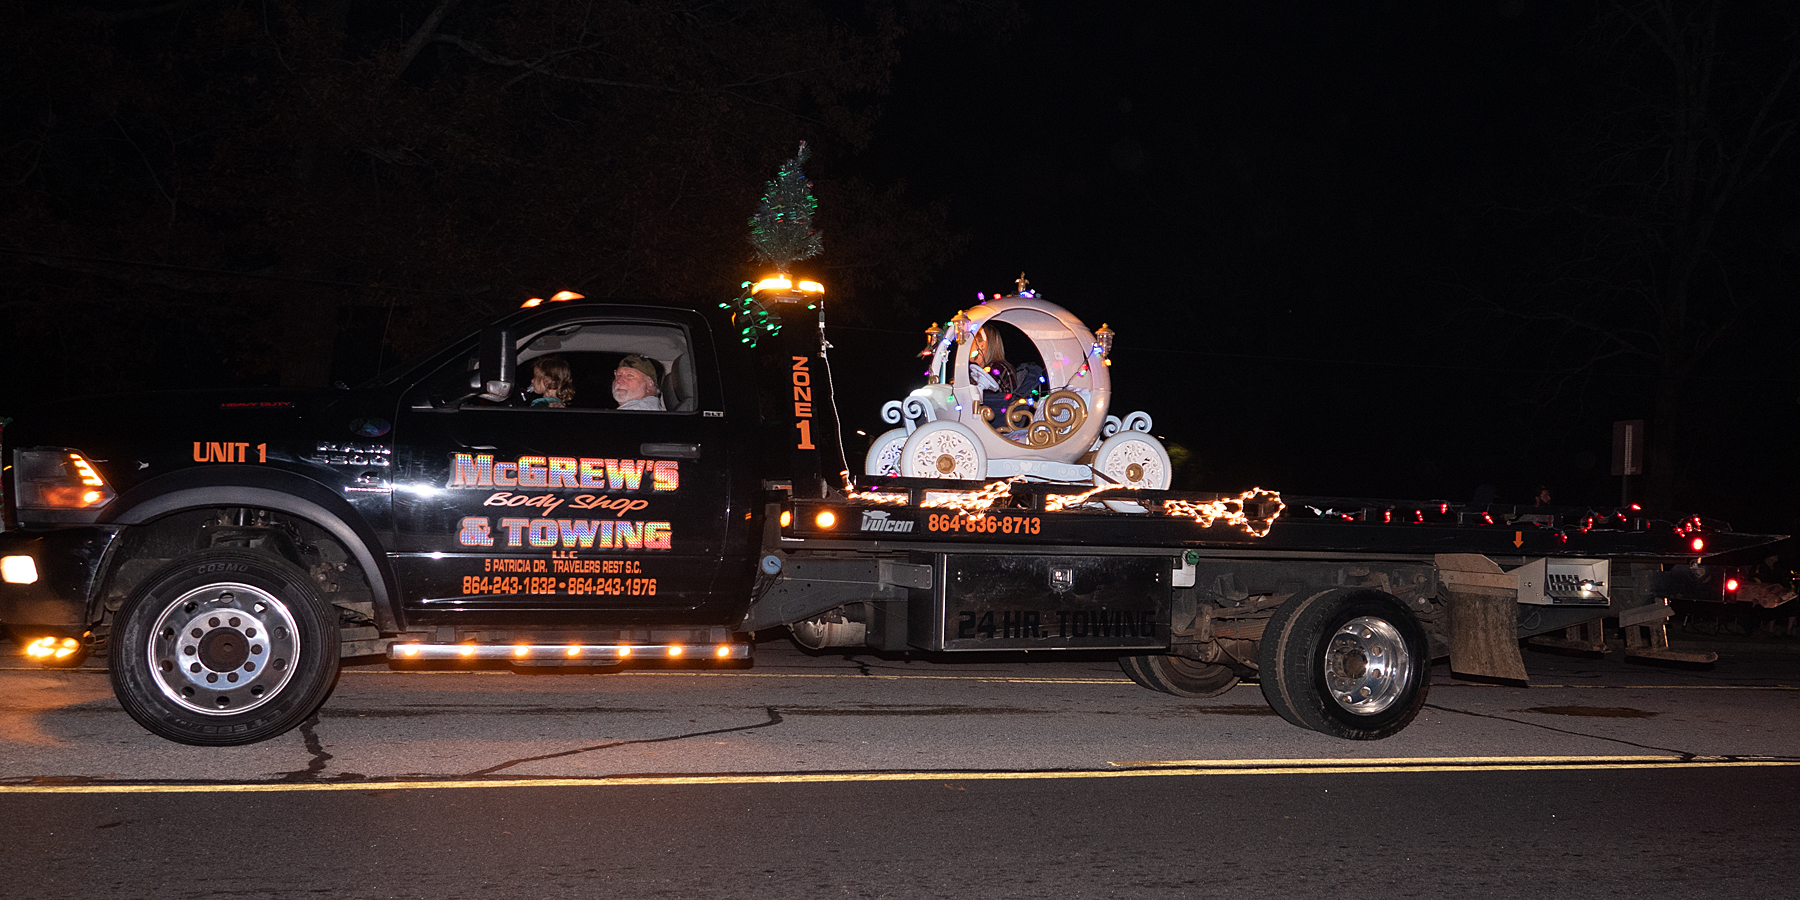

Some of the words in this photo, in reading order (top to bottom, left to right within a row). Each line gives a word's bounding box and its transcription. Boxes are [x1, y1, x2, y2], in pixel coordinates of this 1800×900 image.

[792, 355, 813, 418] ZONE
[796, 419, 816, 450] 1
[193, 441, 250, 463] UNIT
[256, 442, 267, 463] 1
[483, 492, 565, 517] Body
[568, 493, 649, 517] Shop
[459, 516, 495, 547] &
[502, 518, 672, 549] TOWING
[861, 512, 915, 532] Vulcan
[928, 513, 1041, 535] 864-836-8713
[552, 551, 578, 559] LLC
[485, 560, 491, 572] 5
[493, 559, 531, 573] PATRICIA
[533, 560, 548, 573] DR.
[553, 560, 600, 574] TRAVELERS
[602, 561, 624, 574] REST
[625, 561, 642, 574] S.C.
[463, 576, 556, 595] 864-243-1832
[567, 577, 657, 596] 864-243-1976
[958, 610, 997, 638] 24
[1003, 610, 1048, 638] HR.
[1056, 610, 1156, 638] TOWING
